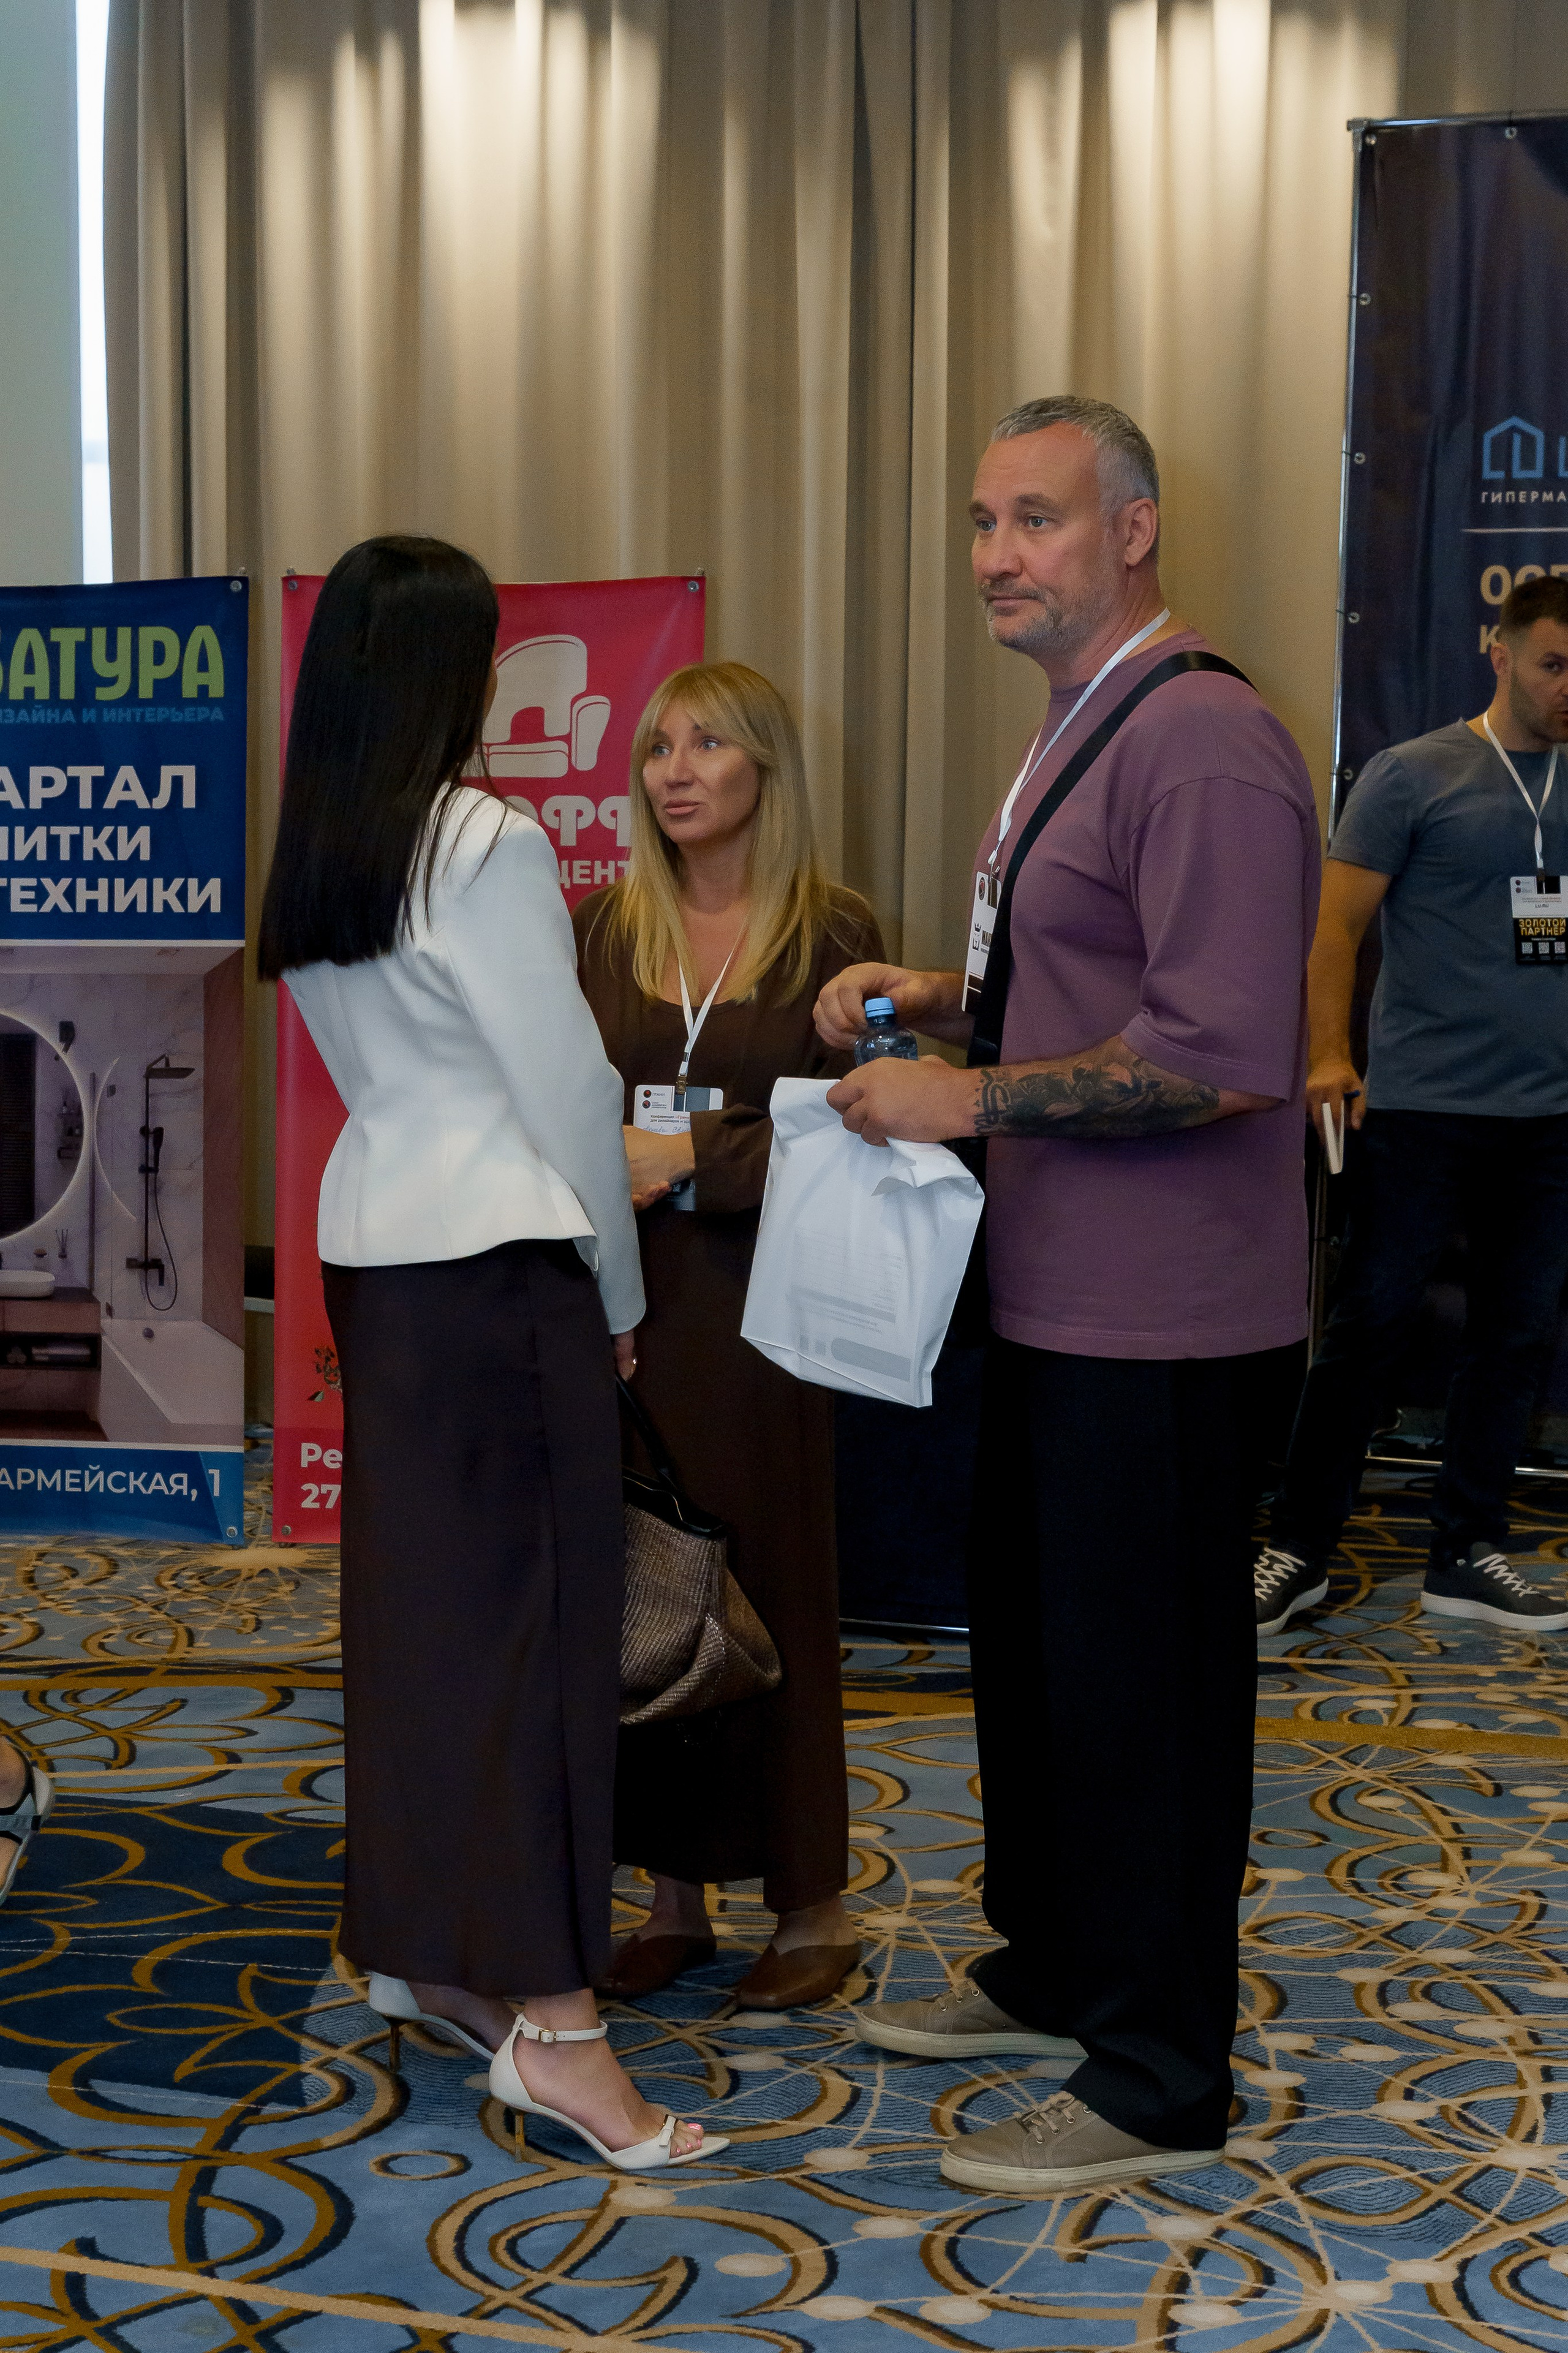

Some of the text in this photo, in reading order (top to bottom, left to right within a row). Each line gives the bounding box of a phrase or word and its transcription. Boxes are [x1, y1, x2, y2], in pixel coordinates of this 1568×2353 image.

[1481, 490, 1567, 504] ГИПЕРМА
[0, 625, 225, 700] АТУРА
[0, 704, 224, 723] ЗАЙНА И ИНТЕРЬЕРА
[0, 826, 151, 861] ИТКИ
[0, 878, 221, 913] ЕХНИКИ
[1519, 918, 1566, 927] ЗОЛОТОЙ
[301, 1443, 342, 1468] Ре
[208, 1469, 221, 1497] 1
[301, 1483, 341, 1509] 27
